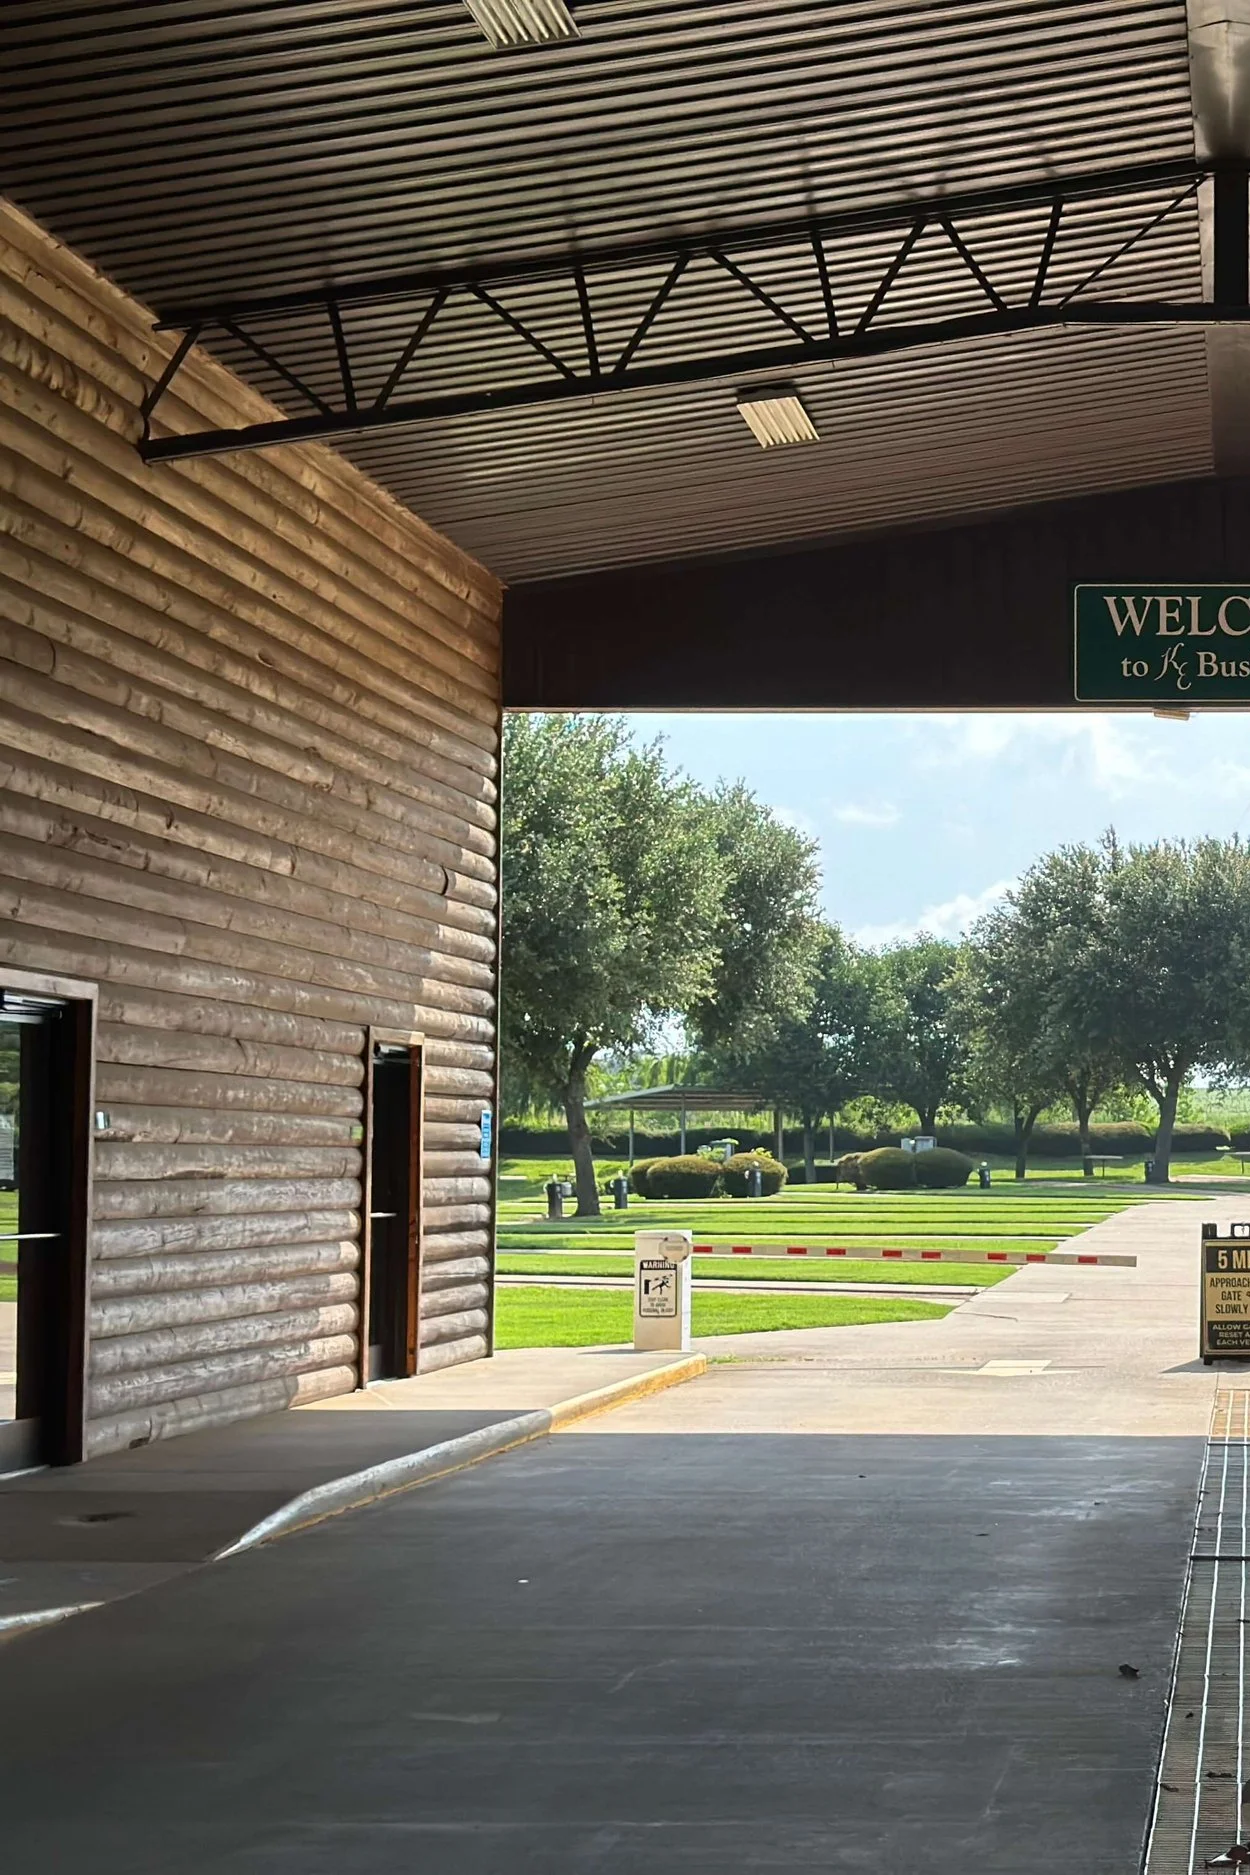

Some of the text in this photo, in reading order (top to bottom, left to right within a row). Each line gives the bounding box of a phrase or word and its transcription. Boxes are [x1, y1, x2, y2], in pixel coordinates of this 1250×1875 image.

[1121, 657, 1149, 677] to
[1217, 1249, 1228, 1269] 5
[1221, 1290, 1242, 1301] GATE
[1215, 1303, 1249, 1314] SLOWLY
[1212, 1323, 1241, 1331] ALLOW
[1216, 1338, 1238, 1346] EACH
